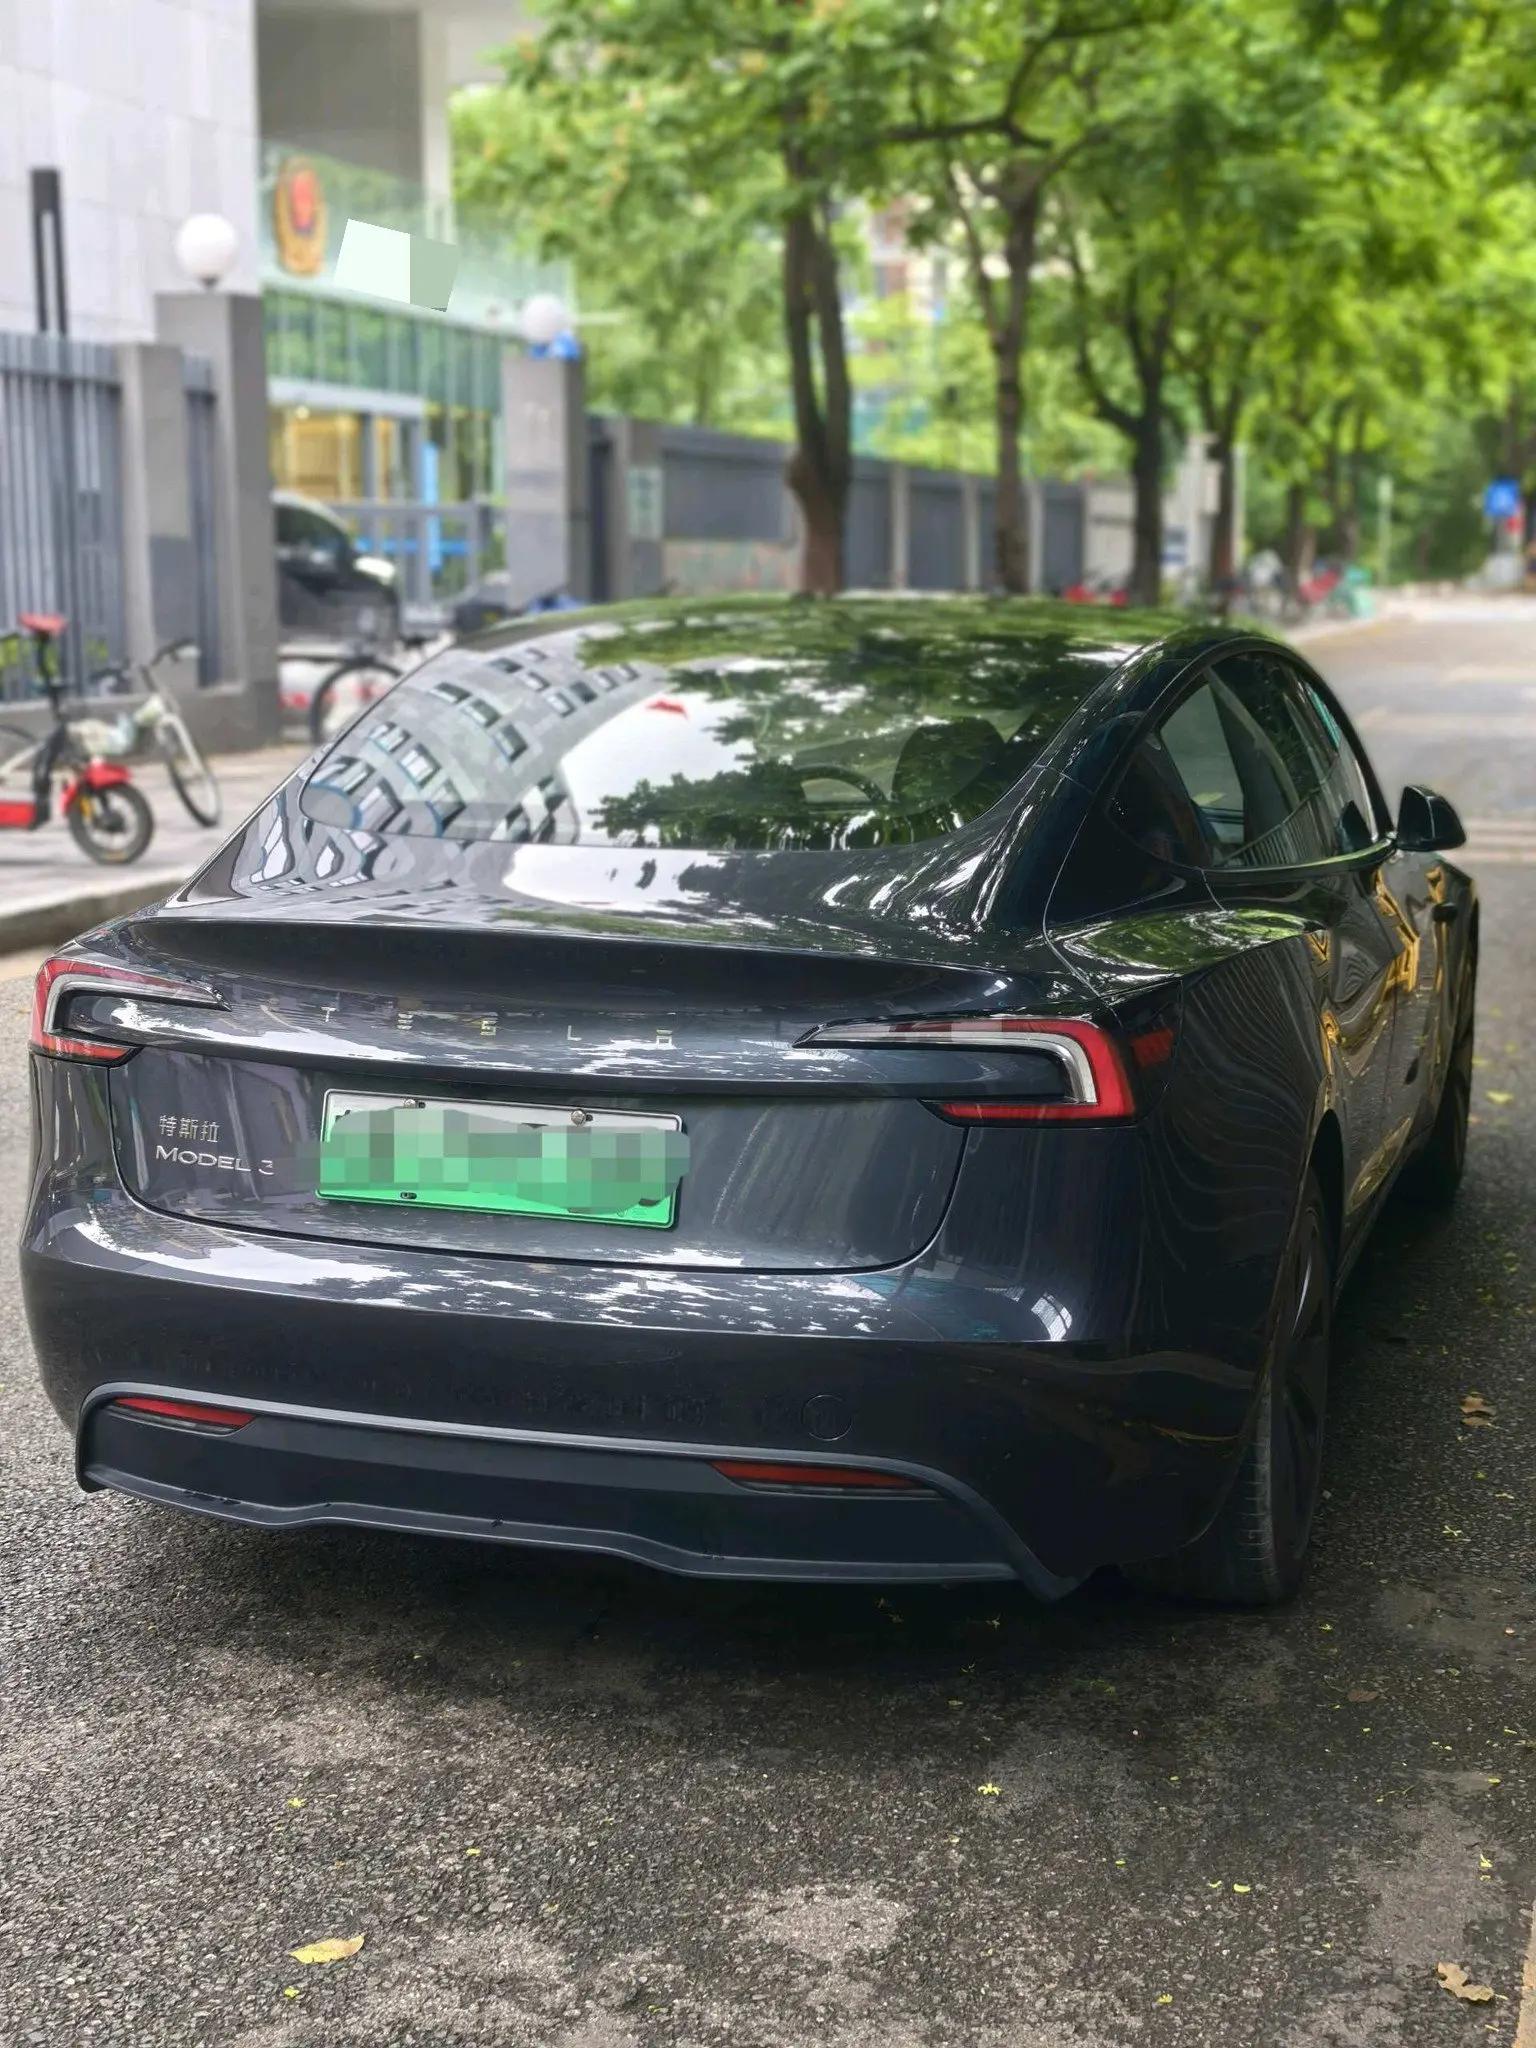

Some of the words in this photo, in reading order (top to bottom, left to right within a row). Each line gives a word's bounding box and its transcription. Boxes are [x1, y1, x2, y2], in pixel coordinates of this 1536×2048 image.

[320, 1006, 673, 1046] TESLA
[159, 1114, 221, 1143] 特斯拉
[155, 1145, 252, 1172] MODEL
[258, 1159, 275, 1176] 3
